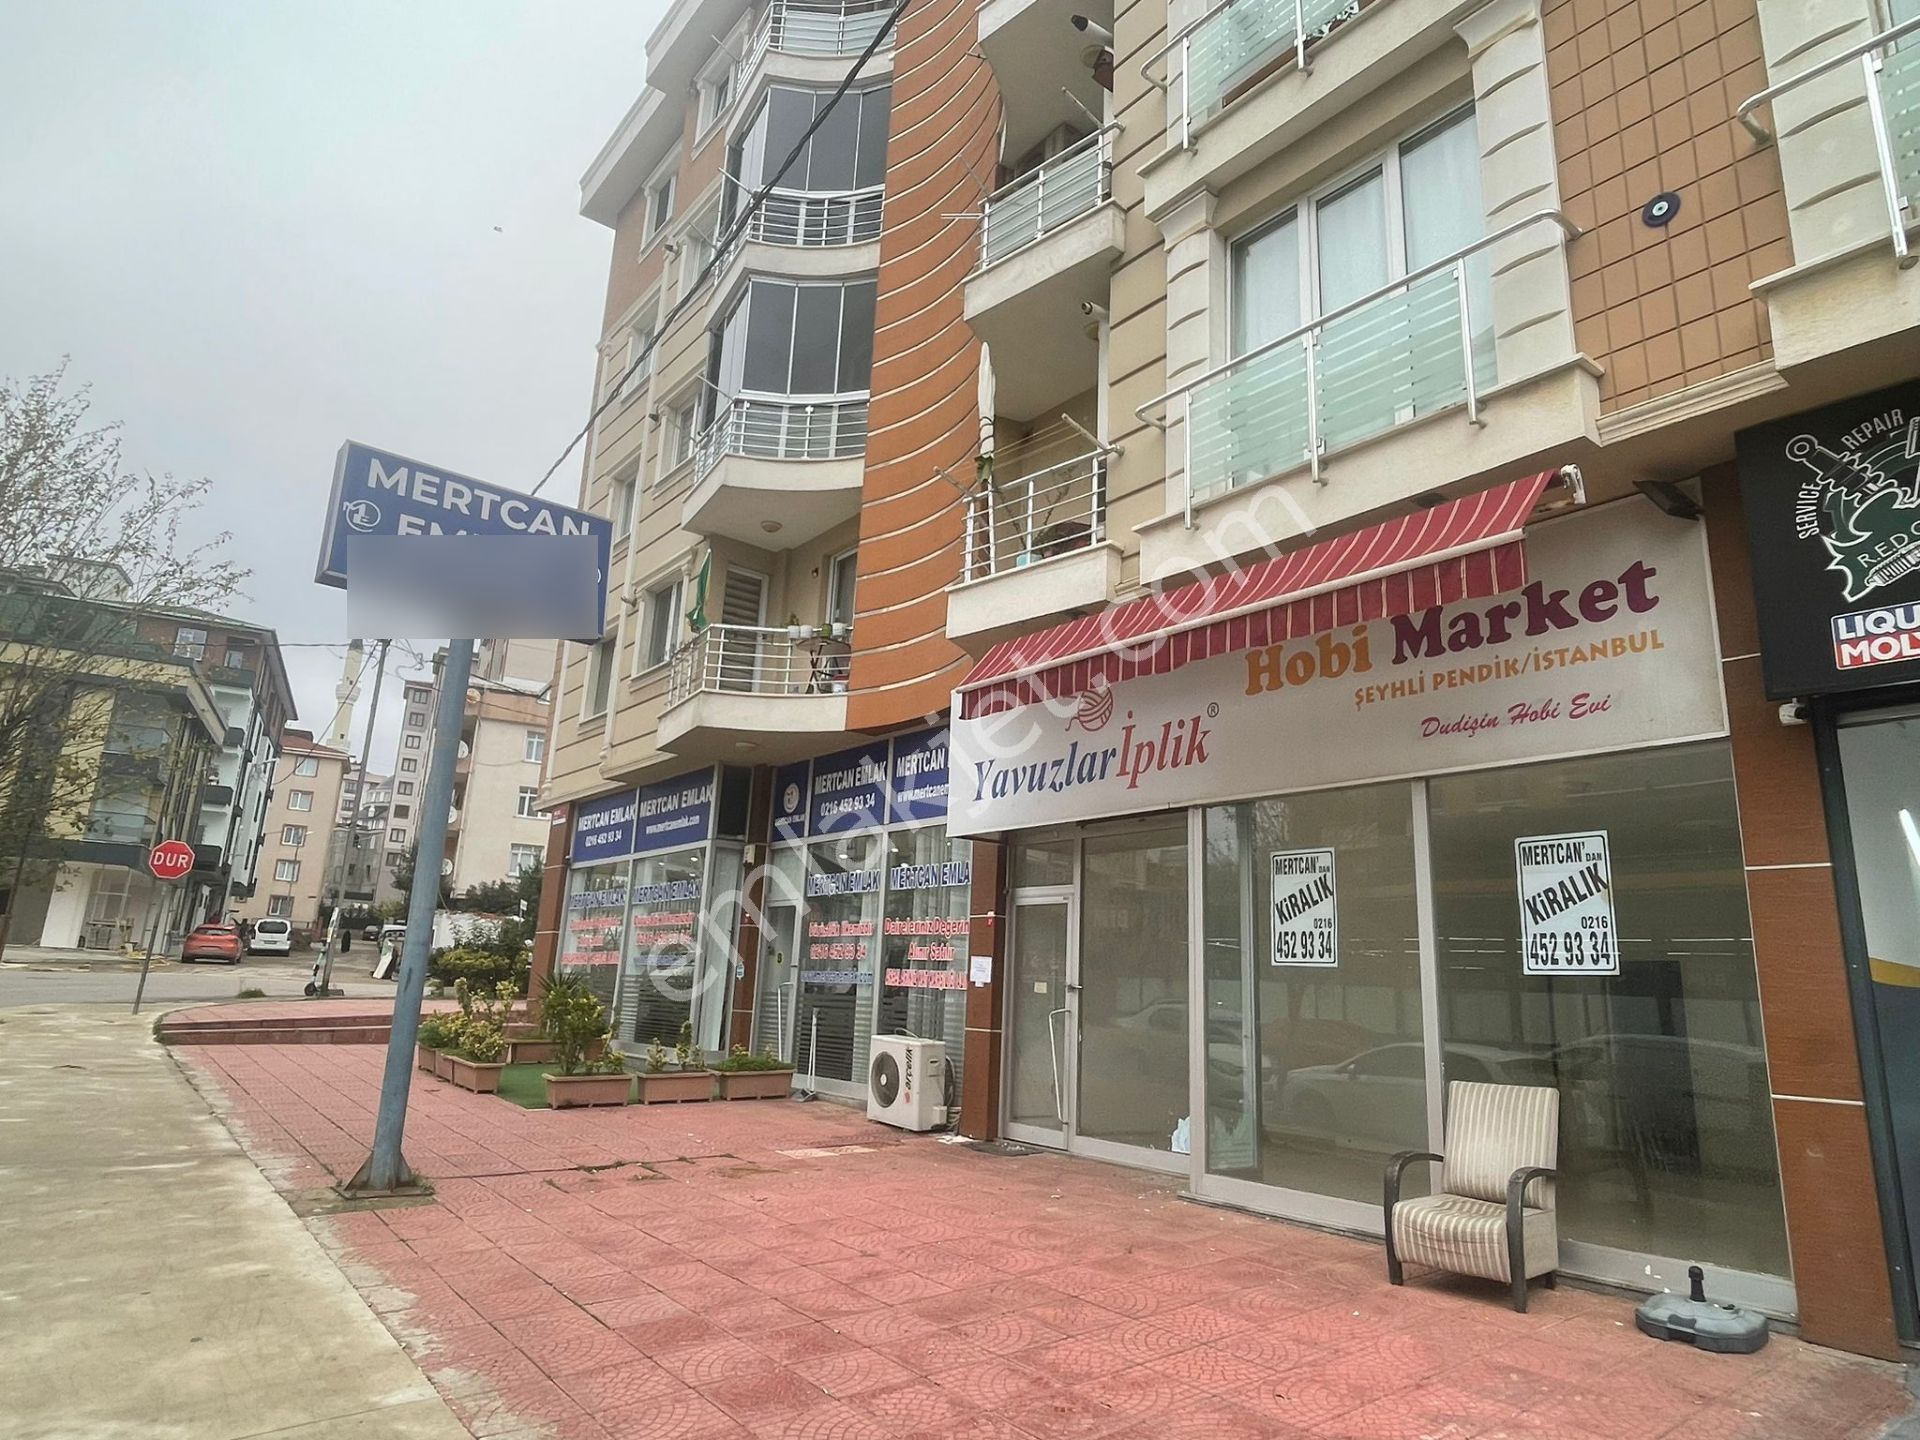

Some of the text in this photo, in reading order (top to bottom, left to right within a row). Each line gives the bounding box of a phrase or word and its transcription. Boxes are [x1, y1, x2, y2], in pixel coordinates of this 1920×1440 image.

[1841, 408, 1904, 450] REPAIR
[367, 457, 590, 536] MERTCAN
[1796, 482, 1823, 540] SERVICE
[1244, 560, 1660, 696] Hobi Market
[1354, 629, 1665, 712] ŞEYHLİ PENDİK/İSTANBUL
[1507, 697, 1561, 725] Hobi
[1568, 692, 1612, 721] Evi
[896, 747, 945, 778] MERTCAN
[814, 761, 887, 796] MERTCAN EMLAK
[640, 784, 713, 818] MERTCAN EMLAK
[838, 797, 853, 813] 452
[853, 795, 865, 811] 93
[864, 792, 876, 808] 34
[577, 810, 610, 832] MERTCAN
[610, 802, 637, 825] EMLAK
[153, 852, 189, 868] DUR
[1274, 857, 1320, 875] MERTCAN'
[1521, 840, 1603, 867] MERTCAN' DAN
[890, 863, 940, 891] MERTCAN
[1313, 917, 1333, 930] 0216
[1581, 916, 1608, 930] 0216
[1276, 930, 1333, 959] 452 93 34
[1529, 931, 1611, 966] 452 93 34
